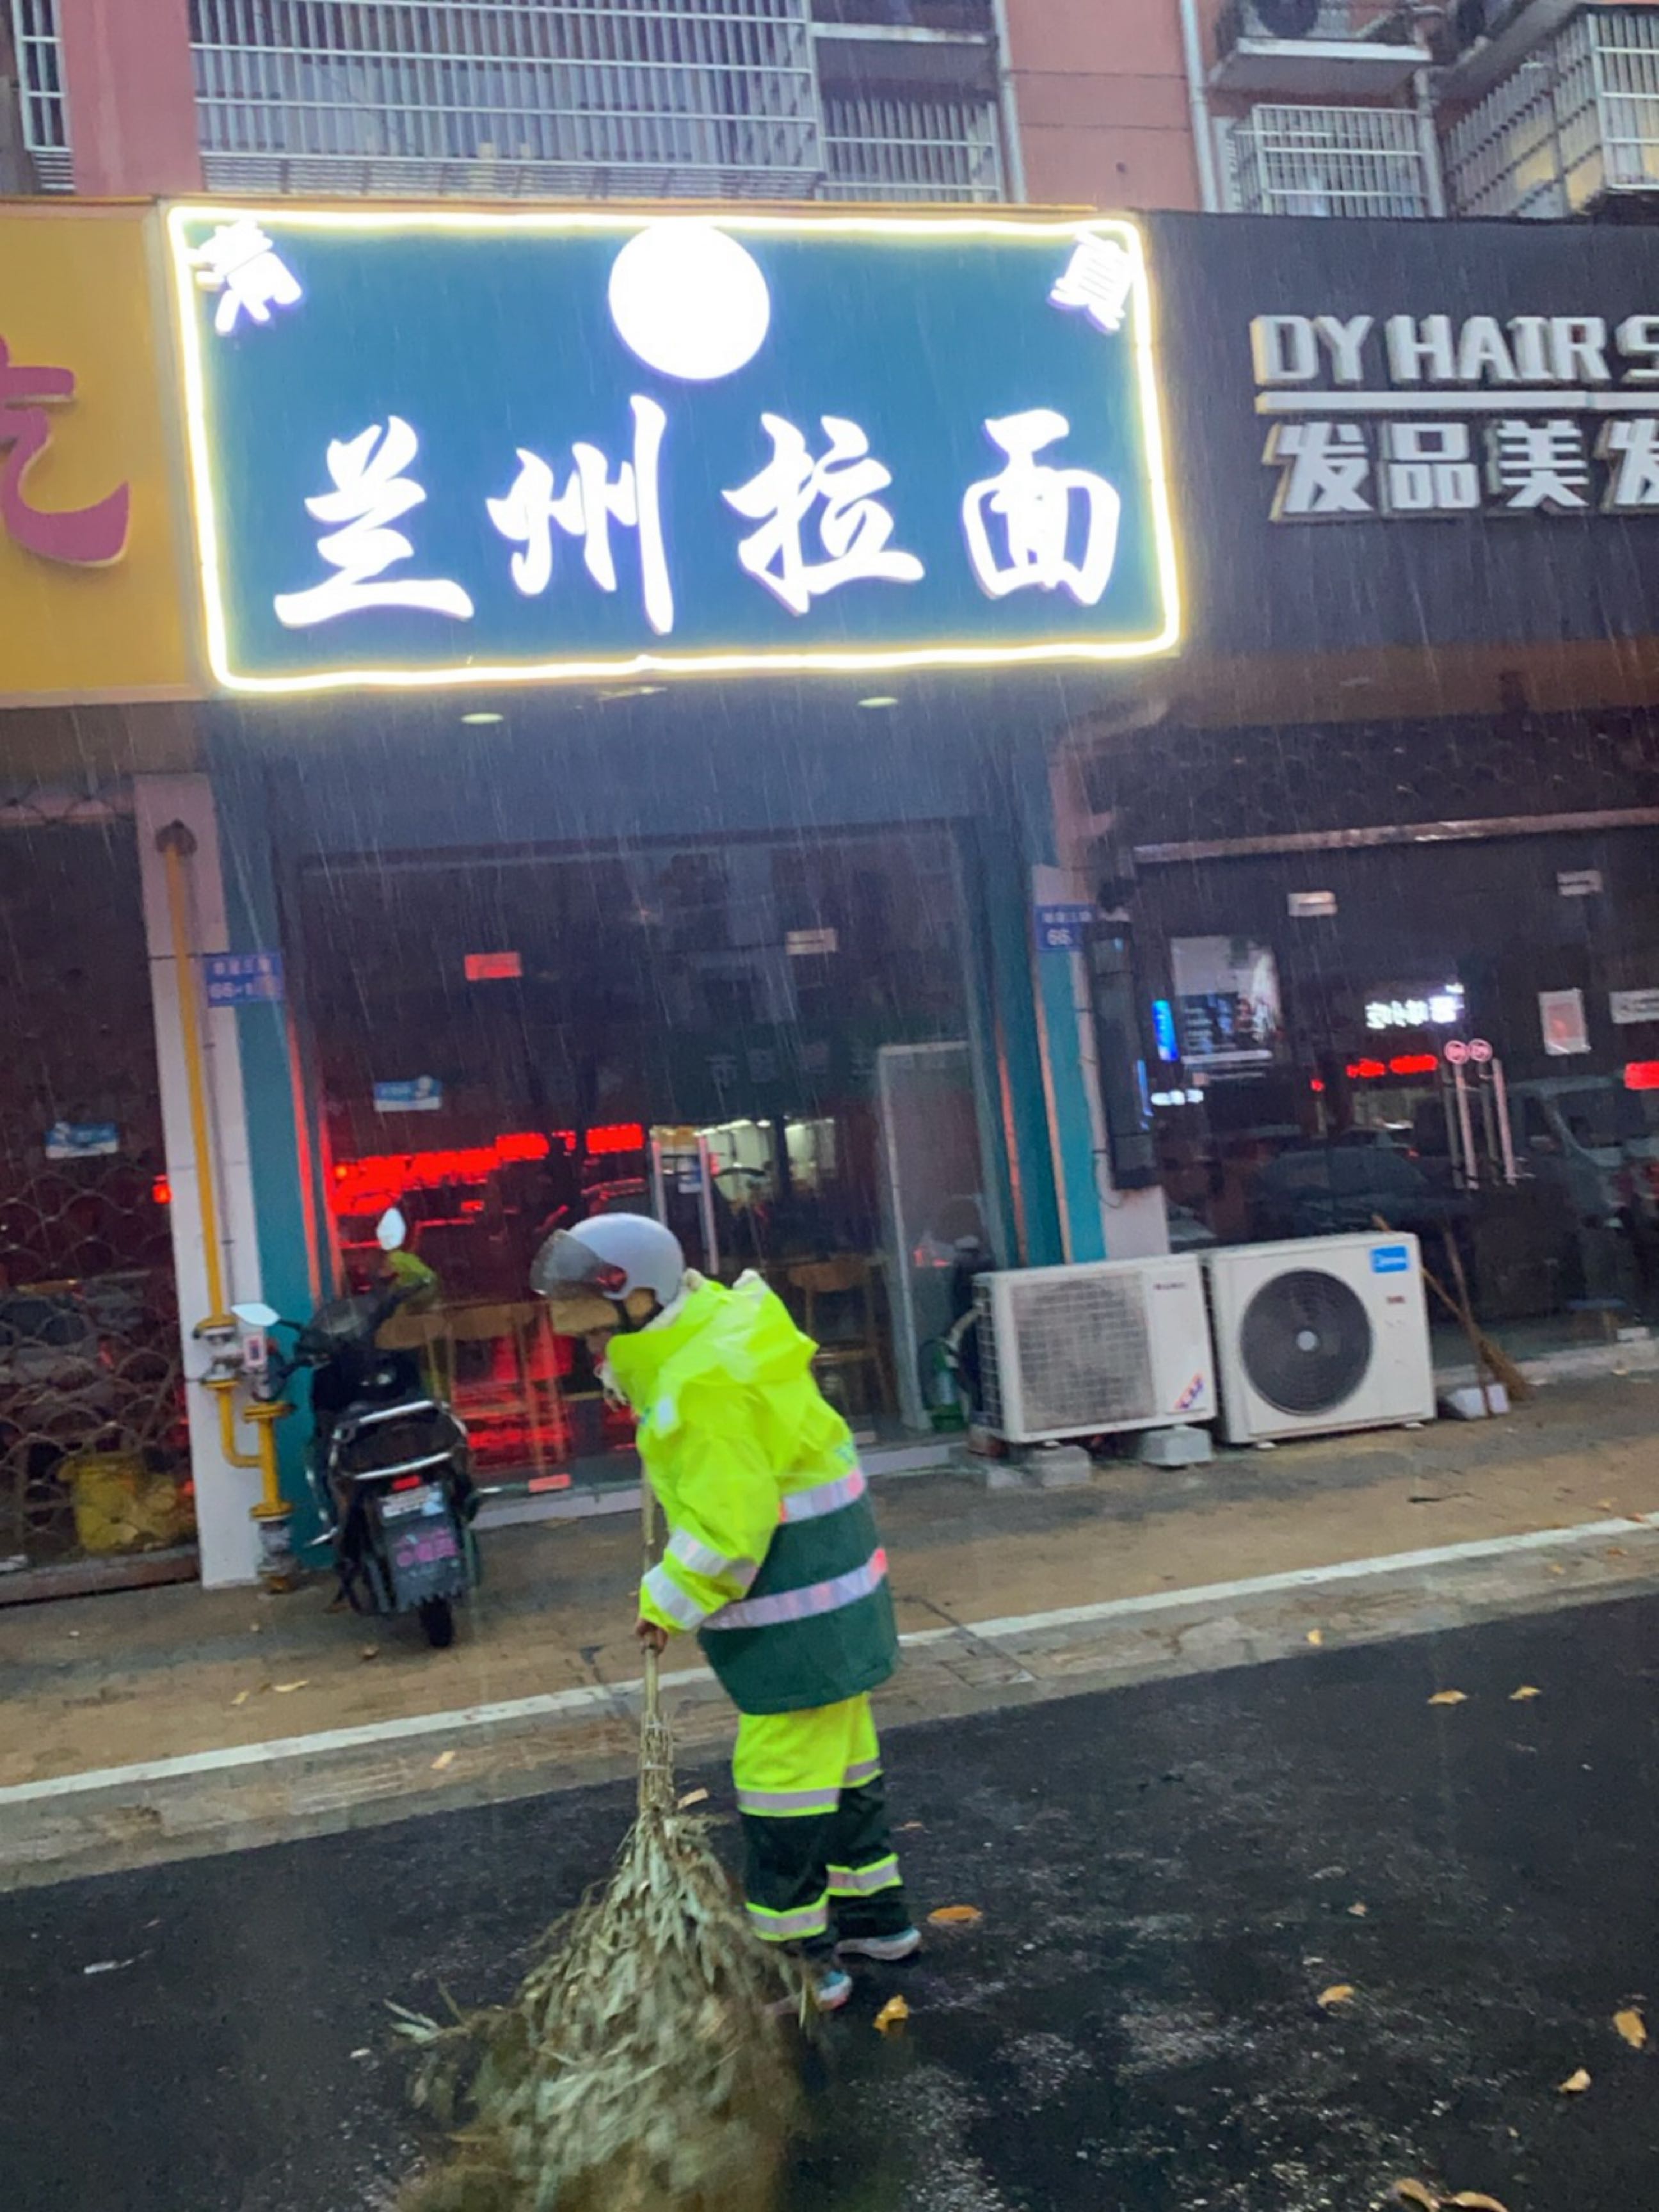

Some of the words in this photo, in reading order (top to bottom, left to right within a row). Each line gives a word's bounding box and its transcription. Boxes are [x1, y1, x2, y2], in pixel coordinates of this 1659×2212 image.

[1250, 314, 1374, 384] DY
[1384, 314, 1613, 384] HAIR
[273, 394, 1122, 634] 兰州拉面
[1262, 419, 1659, 520] 发品美发
